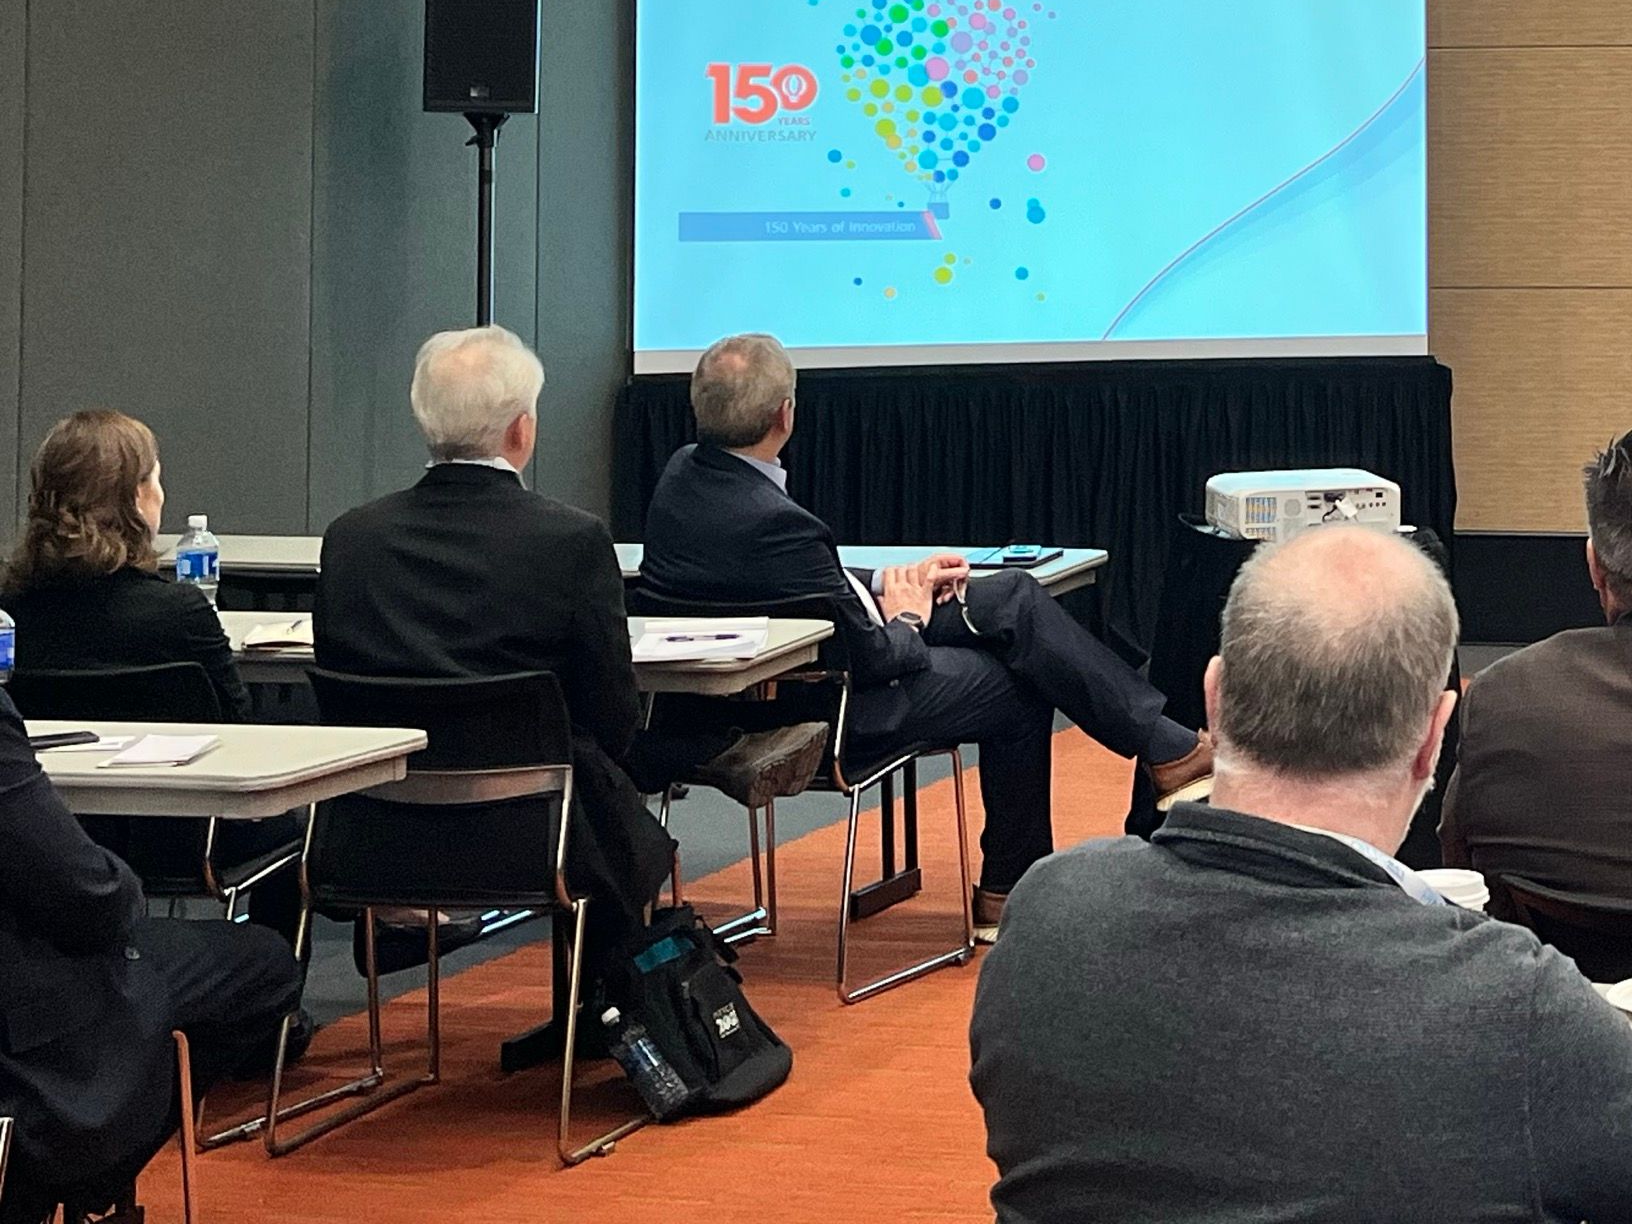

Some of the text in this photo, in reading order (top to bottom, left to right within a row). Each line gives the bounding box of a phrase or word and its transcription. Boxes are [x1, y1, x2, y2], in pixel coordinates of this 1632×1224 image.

[705, 63, 818, 124] 150
[704, 130, 817, 142] ANNIVERSARY
[765, 221, 789, 234] 150
[793, 221, 828, 234] Years
[831, 220, 845, 233] of
